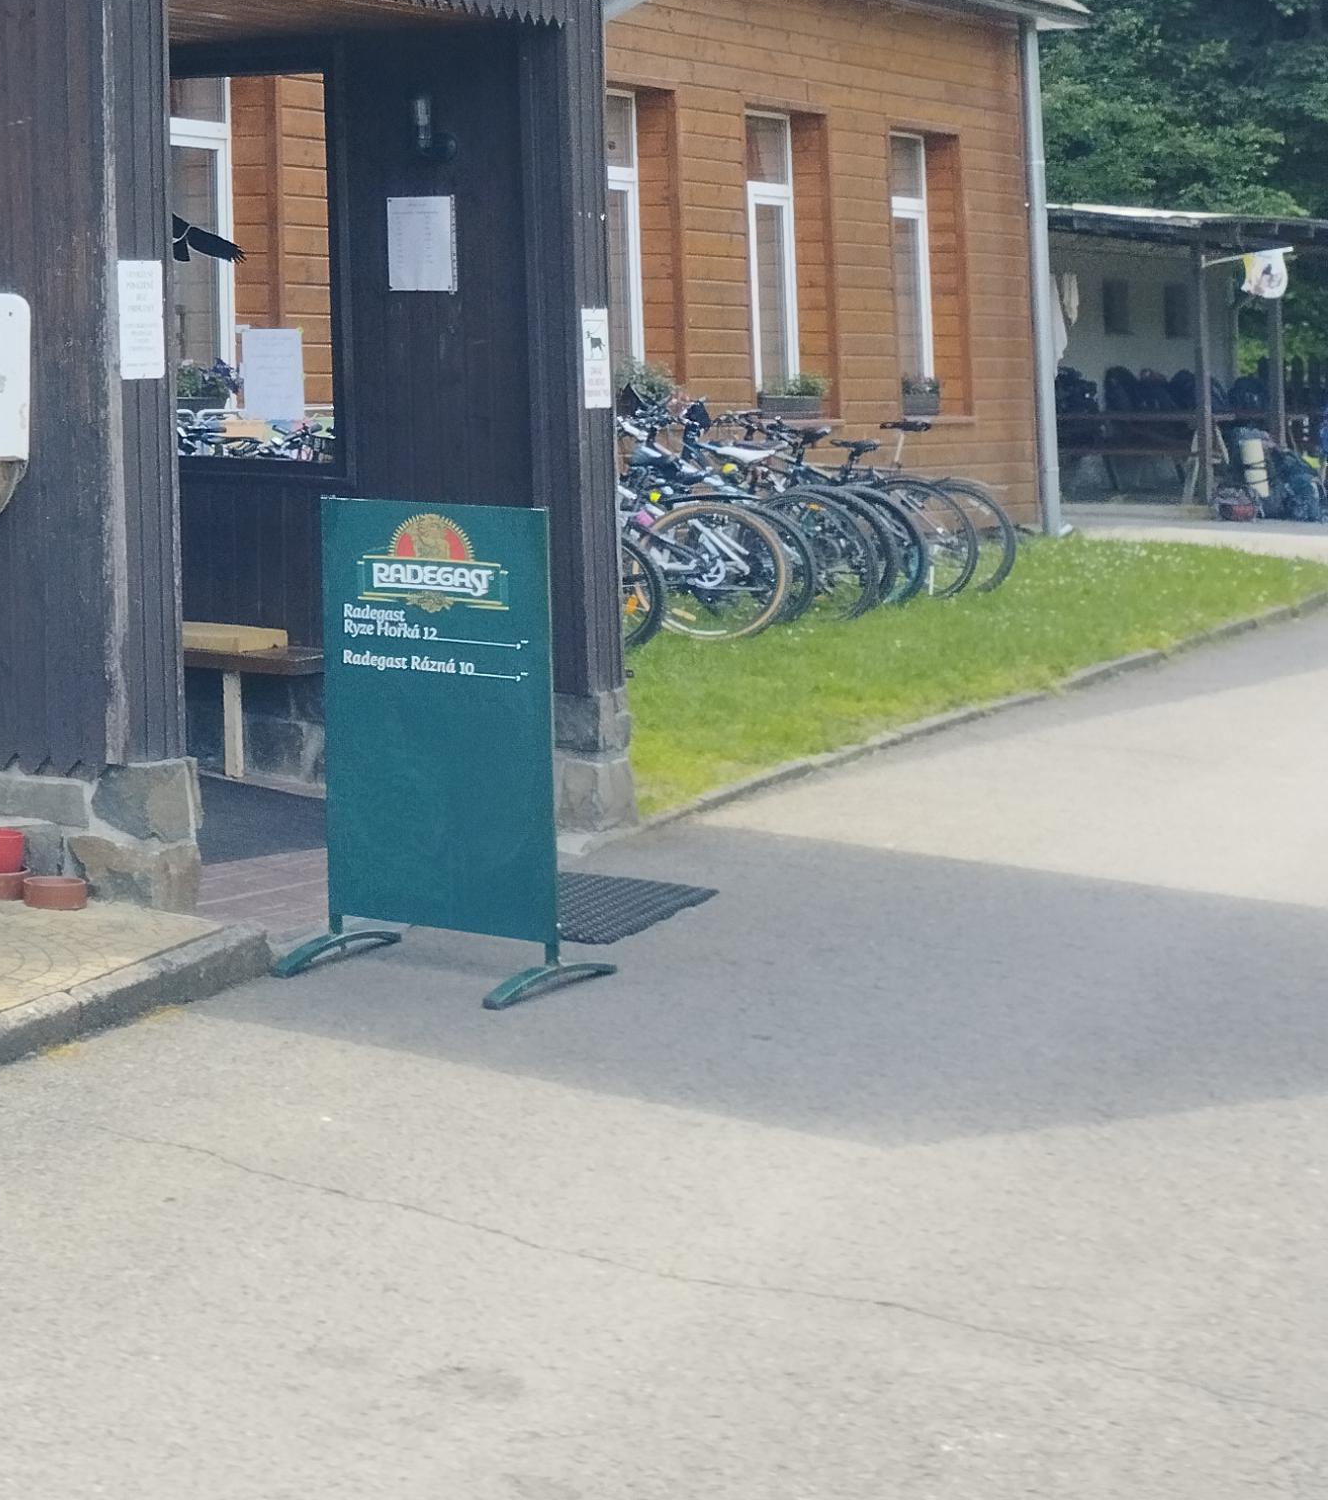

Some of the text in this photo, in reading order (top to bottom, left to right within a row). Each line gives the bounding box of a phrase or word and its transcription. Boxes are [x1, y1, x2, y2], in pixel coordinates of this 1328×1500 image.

[372, 562, 494, 597] RADEGAST
[343, 603, 406, 622] Radegast
[343, 620, 438, 641] Ryze Hořká 12
[342, 649, 475, 676] Radegast Rázná 10
